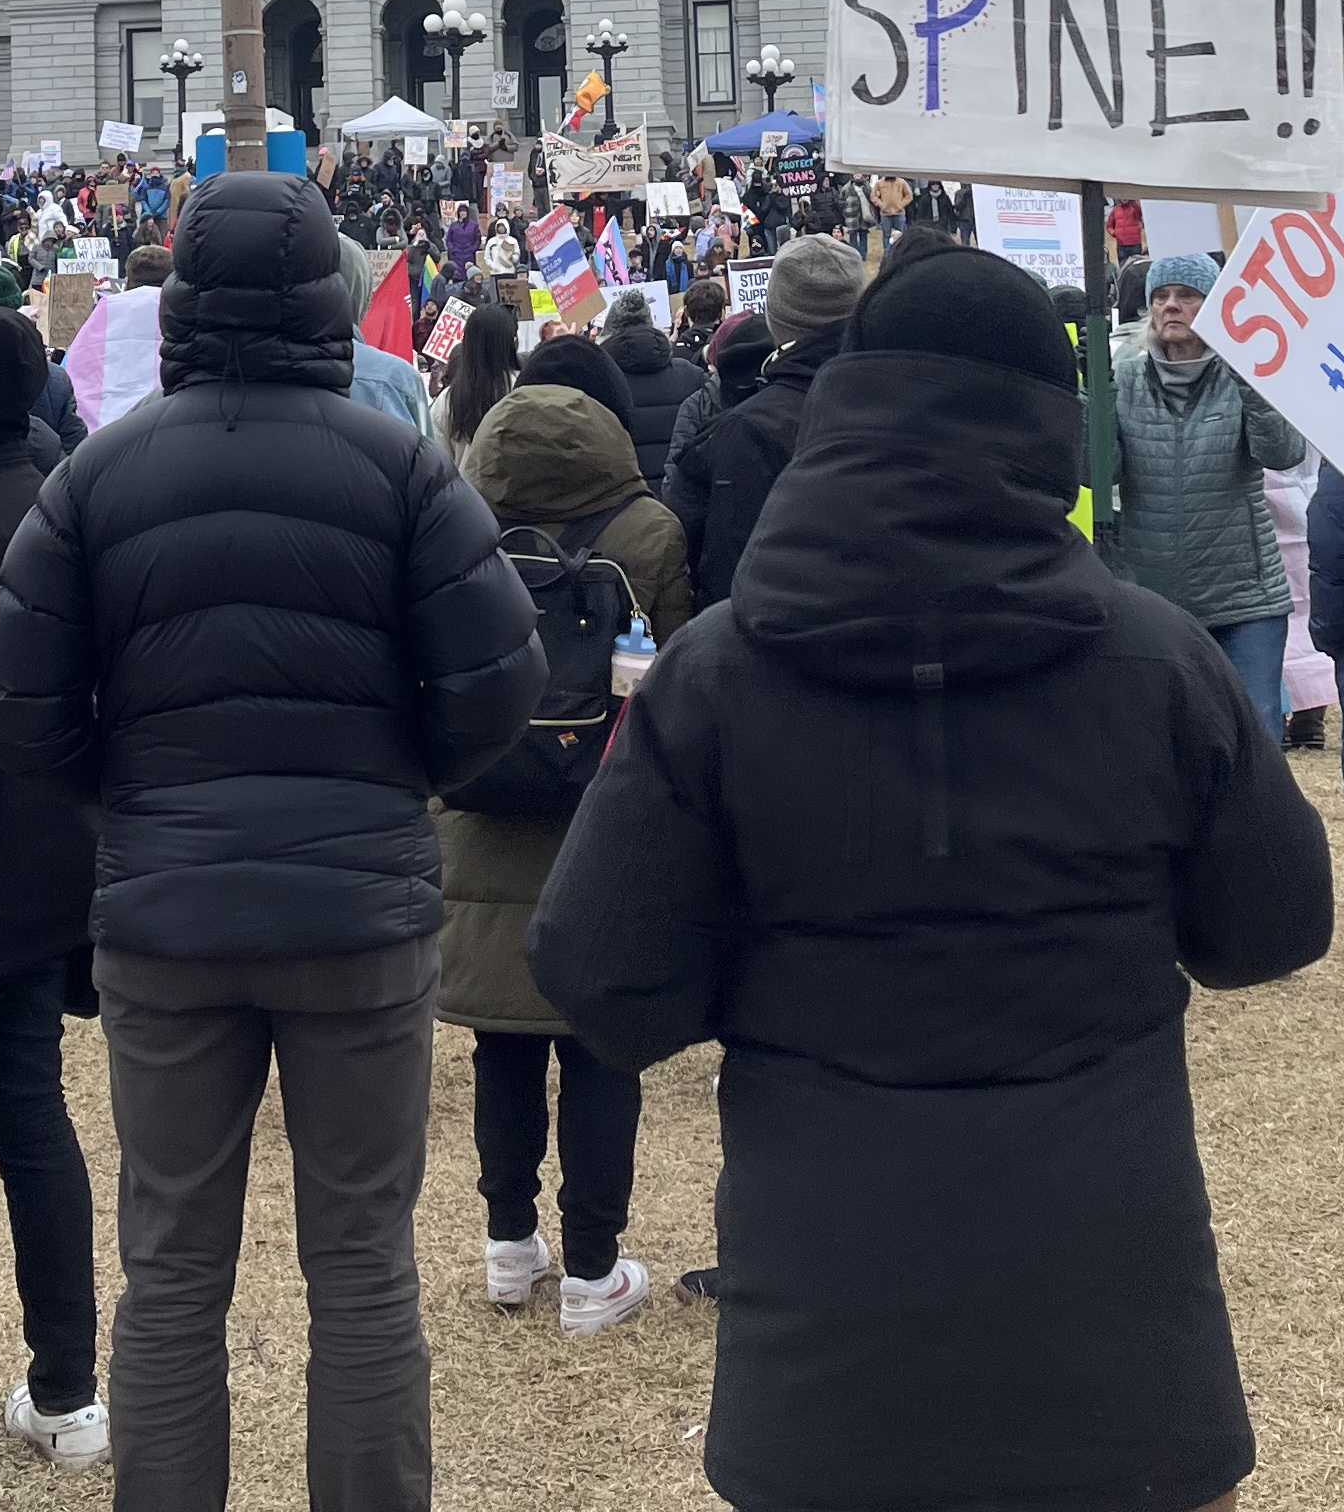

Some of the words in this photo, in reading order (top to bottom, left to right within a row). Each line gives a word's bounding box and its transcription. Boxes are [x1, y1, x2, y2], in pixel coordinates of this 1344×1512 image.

[494, 73, 517, 85] STOP
[496, 85, 511, 94] THE
[778, 158, 814, 171] PROTECT
[780, 169, 816, 184] TRANS
[1066, 253, 1077, 265] UP
[740, 272, 769, 287] STOP
[738, 288, 767, 302] SUPP
[437, 312, 465, 341] SEN
[425, 331, 452, 360] HEL
